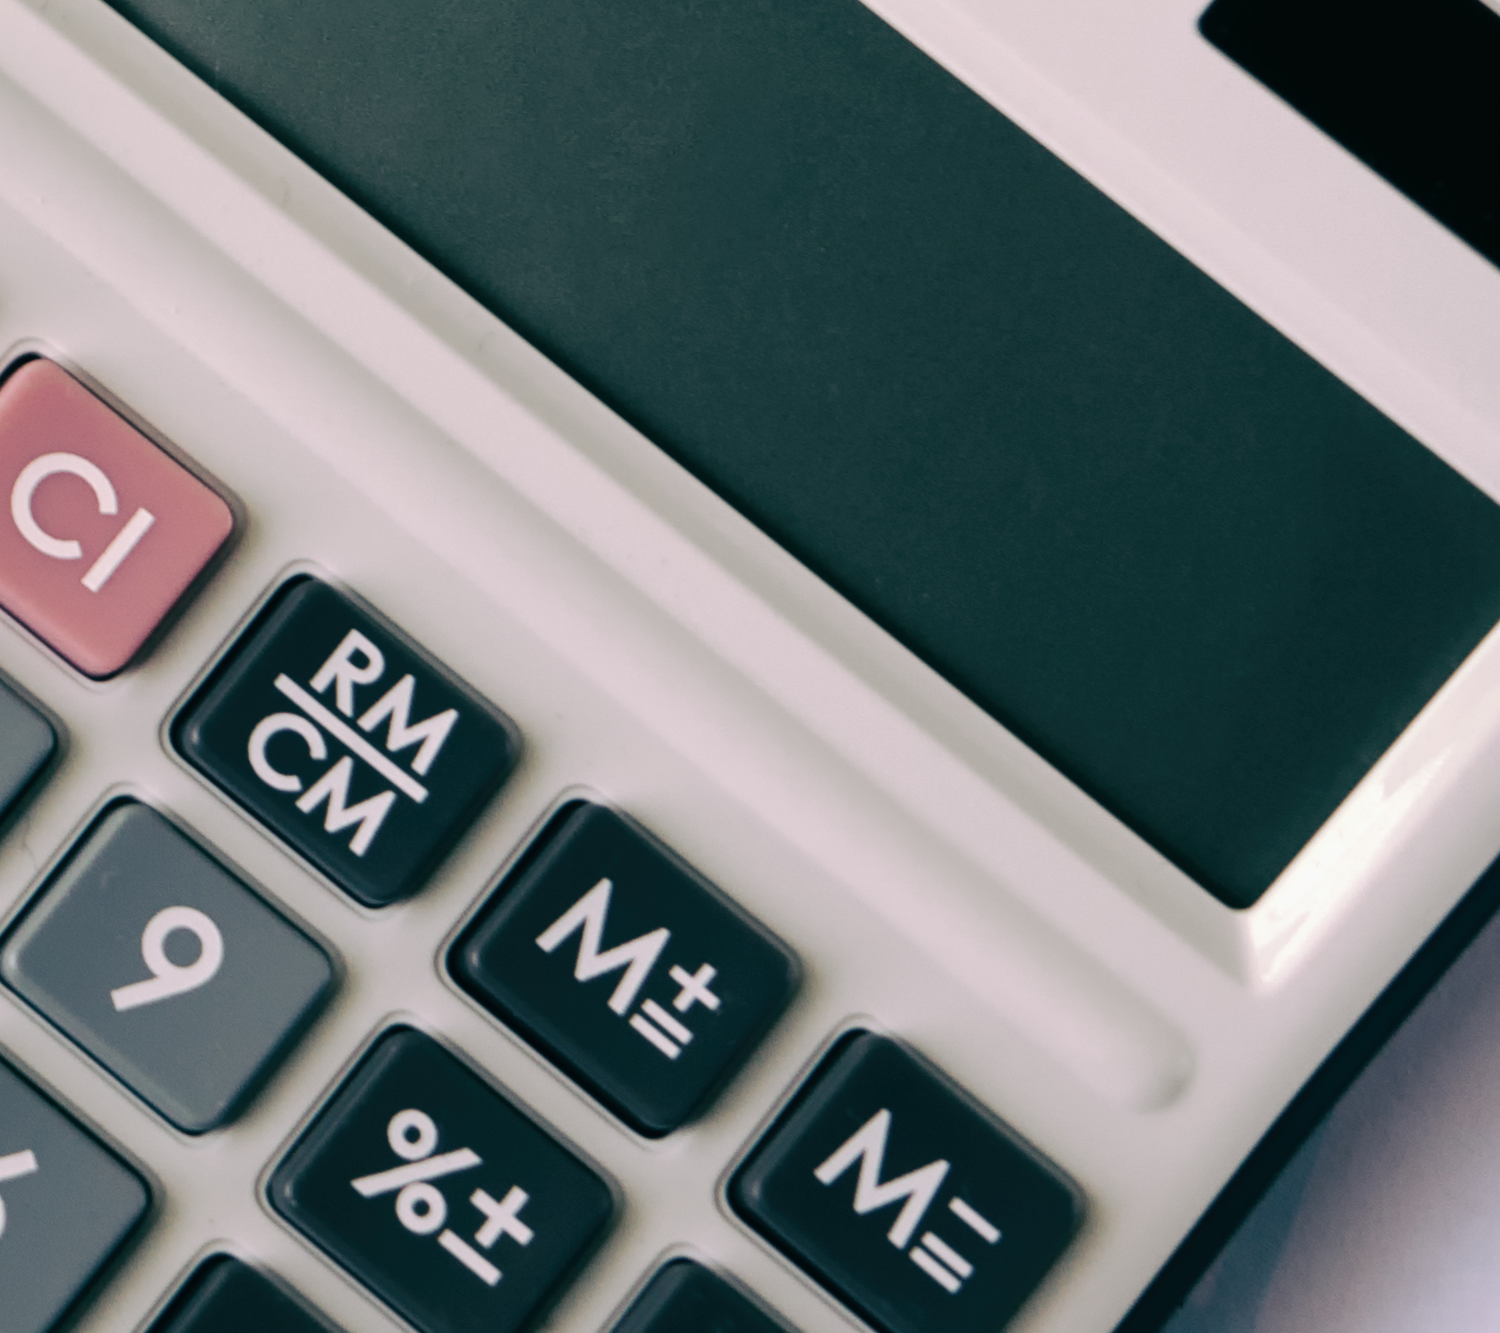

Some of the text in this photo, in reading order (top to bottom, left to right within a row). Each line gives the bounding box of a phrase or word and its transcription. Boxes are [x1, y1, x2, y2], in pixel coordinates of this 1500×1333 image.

[309, 629, 458, 776] RM
[248, 712, 395, 857] CM
[110, 906, 223, 1011] 9
